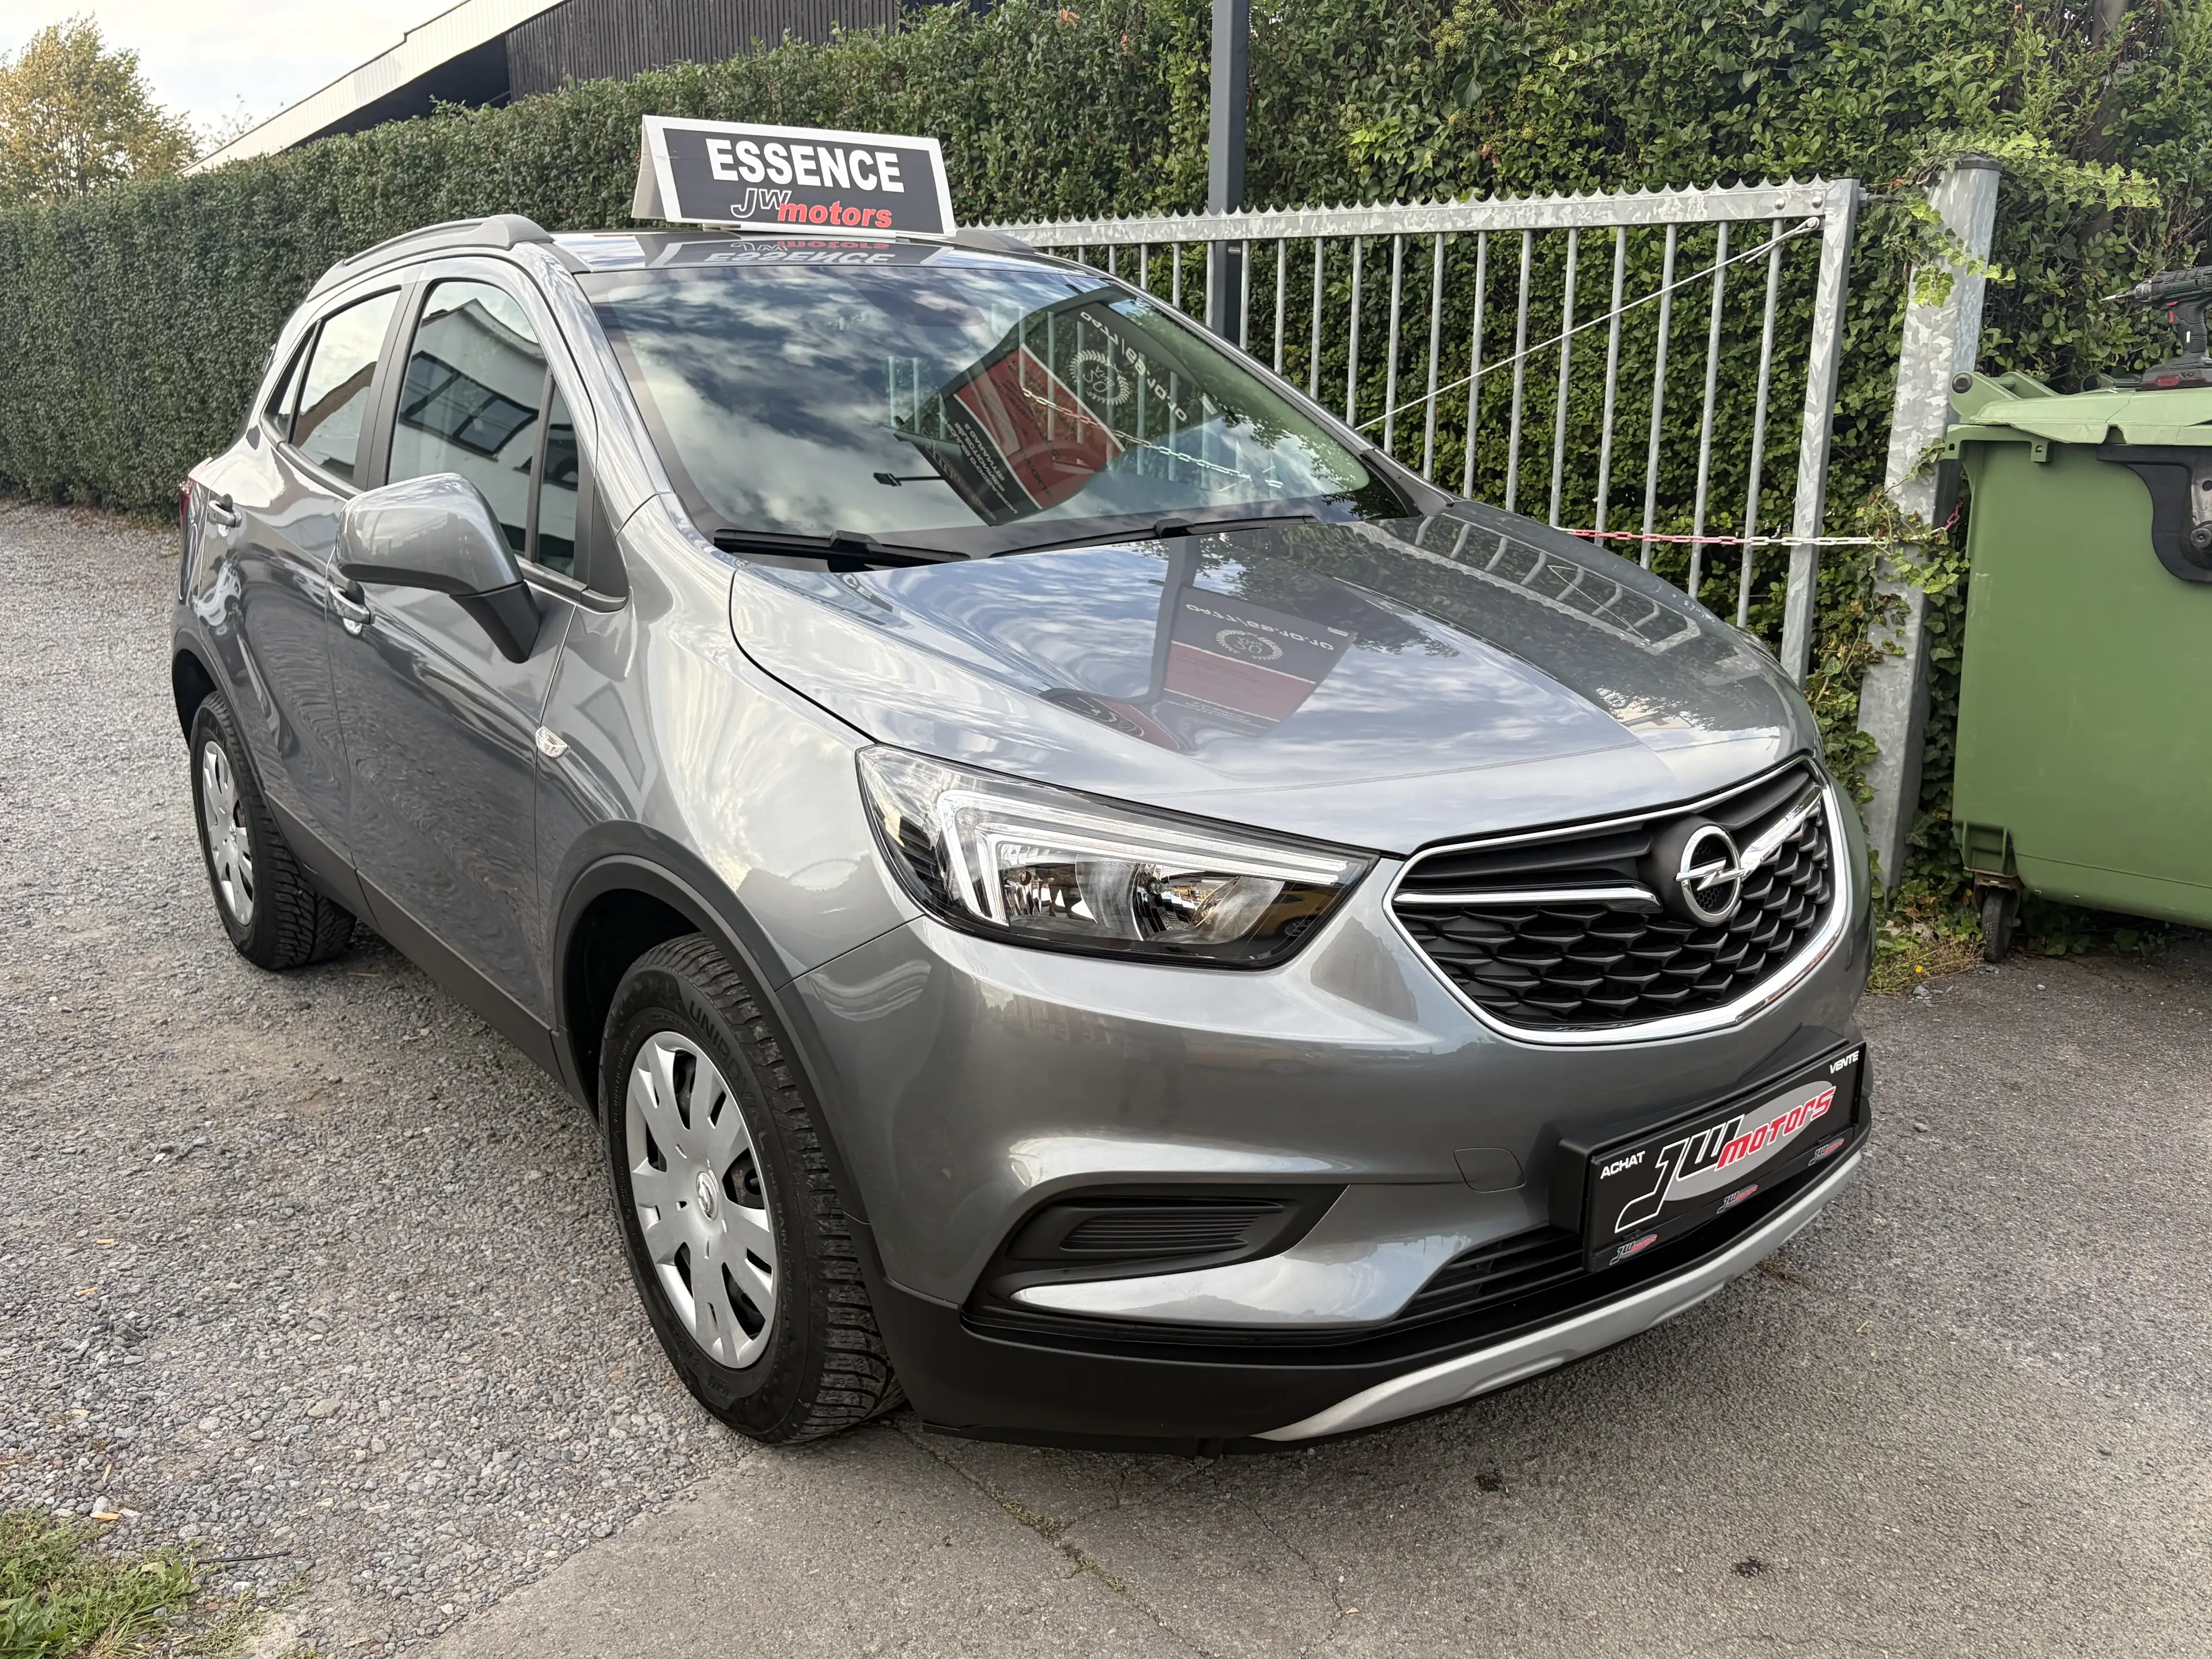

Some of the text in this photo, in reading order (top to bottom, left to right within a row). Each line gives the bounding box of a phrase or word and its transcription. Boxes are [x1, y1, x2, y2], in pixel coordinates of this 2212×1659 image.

[706, 138, 905, 193] ESSENCE
[730, 187, 892, 228] JW motors
[1830, 1050, 1859, 1074] VENTE
[1600, 1150, 1645, 1179] ACHAT
